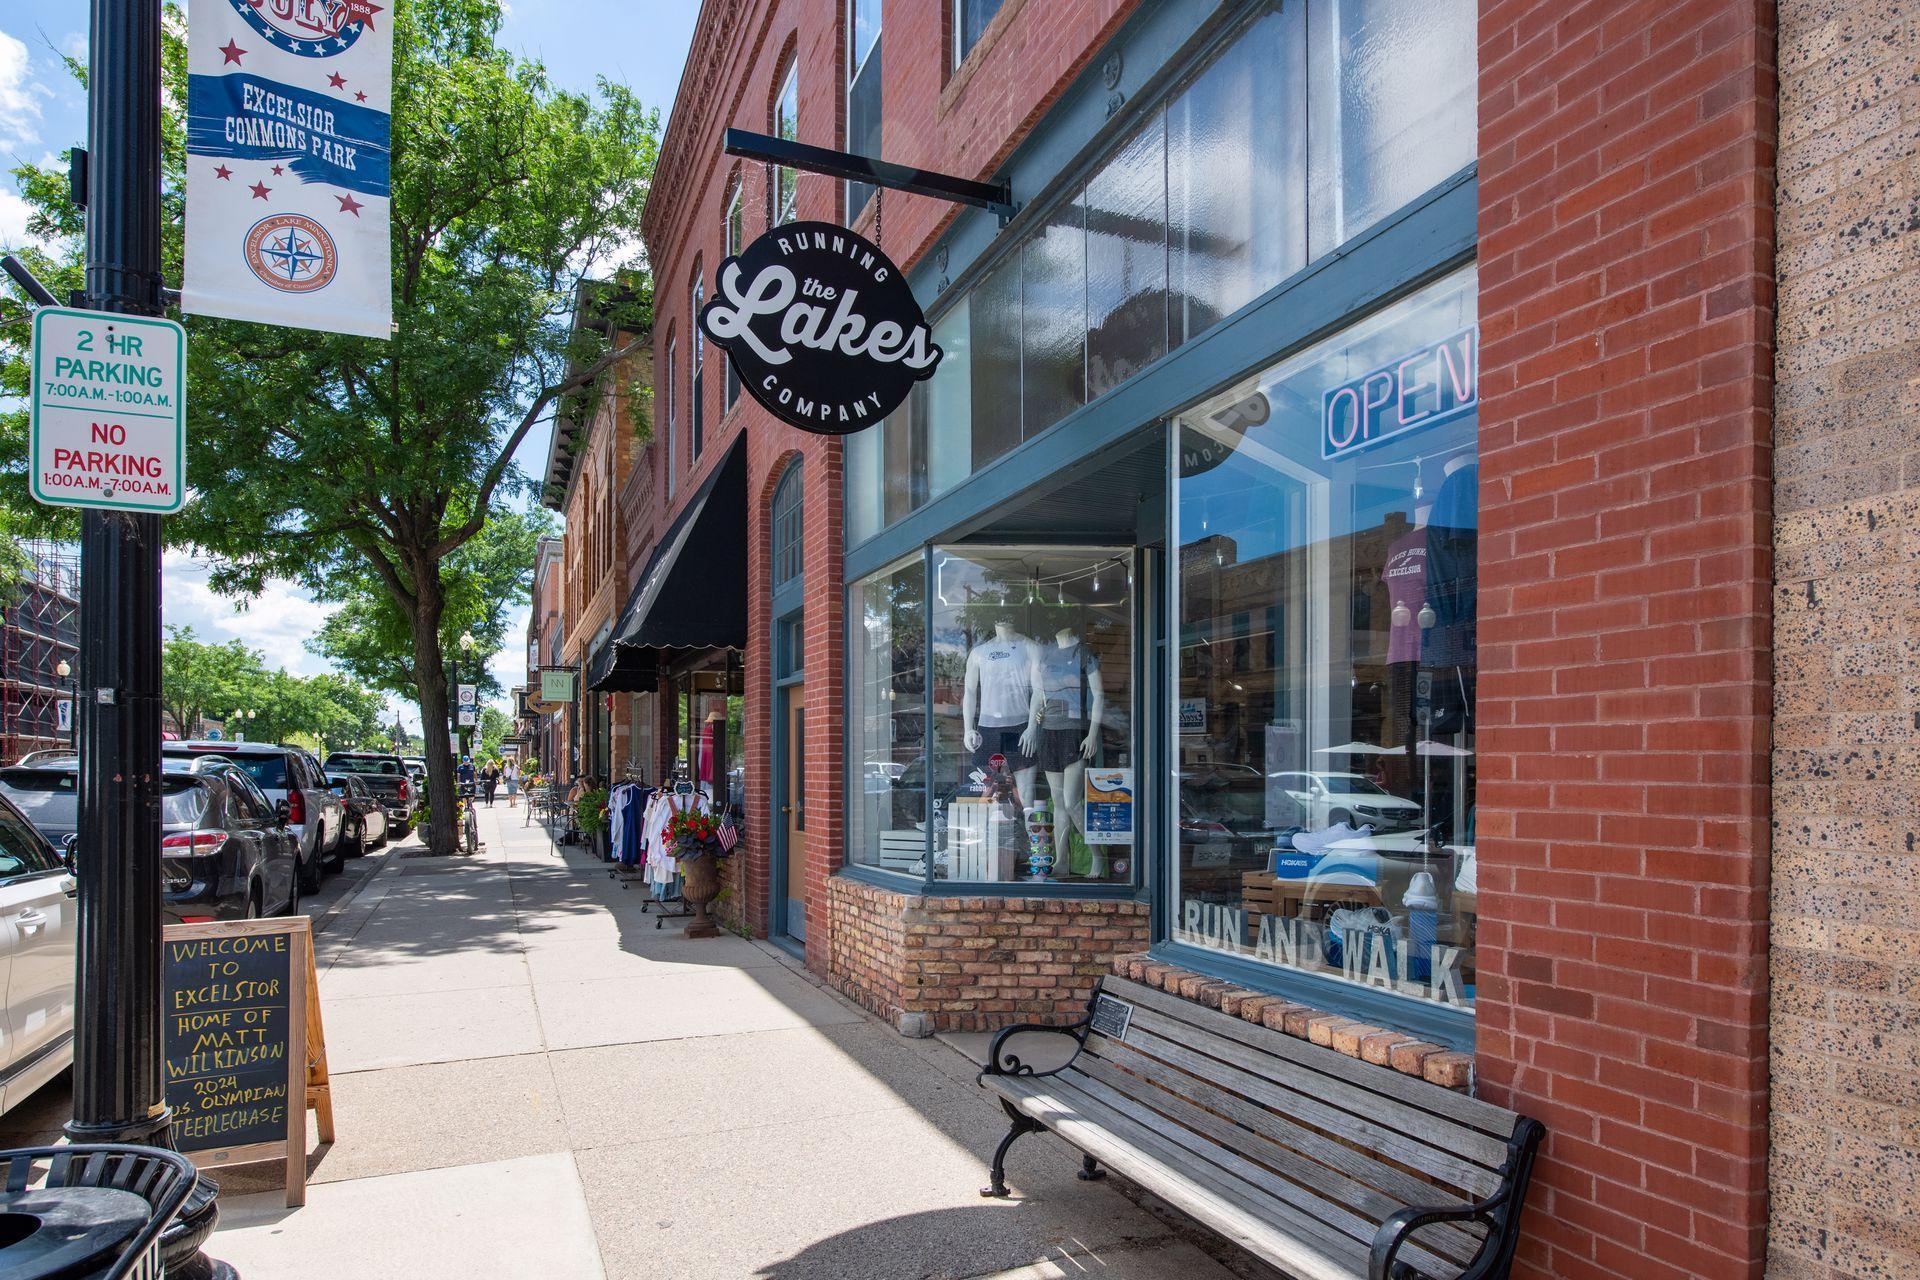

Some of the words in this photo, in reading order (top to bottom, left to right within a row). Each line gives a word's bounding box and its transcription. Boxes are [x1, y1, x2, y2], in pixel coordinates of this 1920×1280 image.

[350, 2, 372, 15] 1888
[242, 82, 336, 138] EXCELSIOR
[224, 116, 308, 151] COMMONS
[311, 136, 357, 172] PARK
[250, 223, 271, 264] EXCELSIOR
[777, 232, 888, 283] RUNNING
[802, 276, 837, 300] the
[706, 261, 938, 369] Lakes
[76, 330, 94, 352] 2
[107, 333, 143, 357] HR
[55, 356, 163, 388] PARKING
[762, 374, 882, 422] COMPANY
[1328, 333, 1471, 448] OPEN
[91, 422, 126, 446] NO
[54, 448, 162, 478] PARKING
[1388, 564, 1421, 577] EXCELSIOR
[1281, 859, 1299, 867] HOKA
[1367, 924, 1391, 936] HOKA
[172, 936, 286, 962] WELCOME
[1184, 899, 1243, 953] RUN
[1255, 913, 1323, 970] AND
[1342, 926, 1463, 1007] WALK
[208, 961, 240, 979] TO
[174, 978, 280, 1010] EXCELSIOR
[177, 1011, 232, 1037] HOME
[243, 1009, 272, 1024] OF
[192, 1028, 268, 1054] MATT
[166, 1041, 284, 1078] WILKINSON
[171, 1100, 195, 1117] U.S.
[200, 1084, 286, 1111] OLYMPIAN
[193, 1075, 238, 1095] 2024
[172, 1106, 284, 1140] TEEPLECHASE
